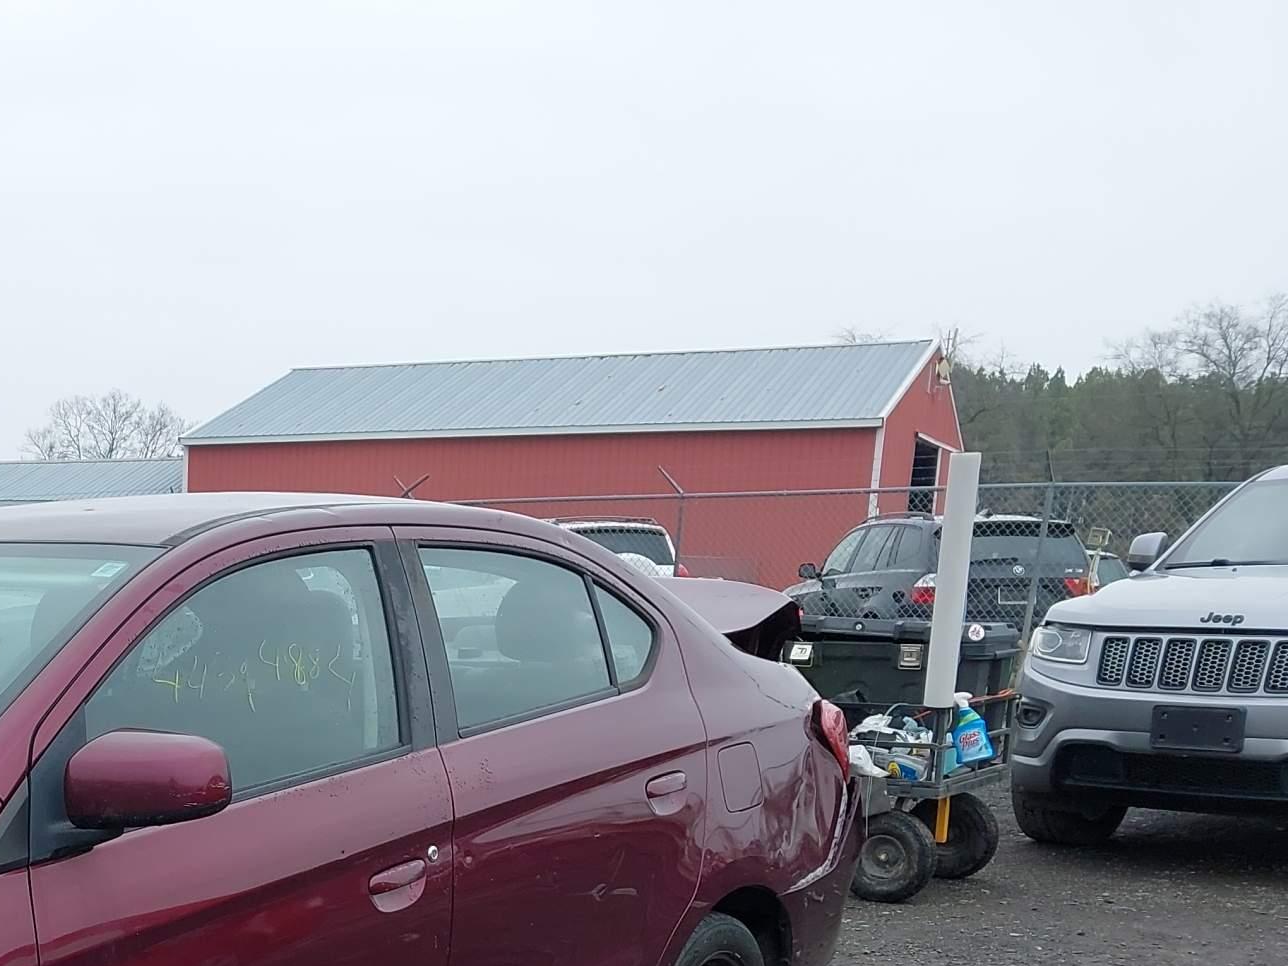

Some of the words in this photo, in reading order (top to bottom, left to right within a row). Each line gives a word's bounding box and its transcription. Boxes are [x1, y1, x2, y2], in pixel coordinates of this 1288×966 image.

[1200, 611, 1244, 626] Jeep
[960, 731, 980, 743] Glass
[962, 738, 980, 750] Plus
